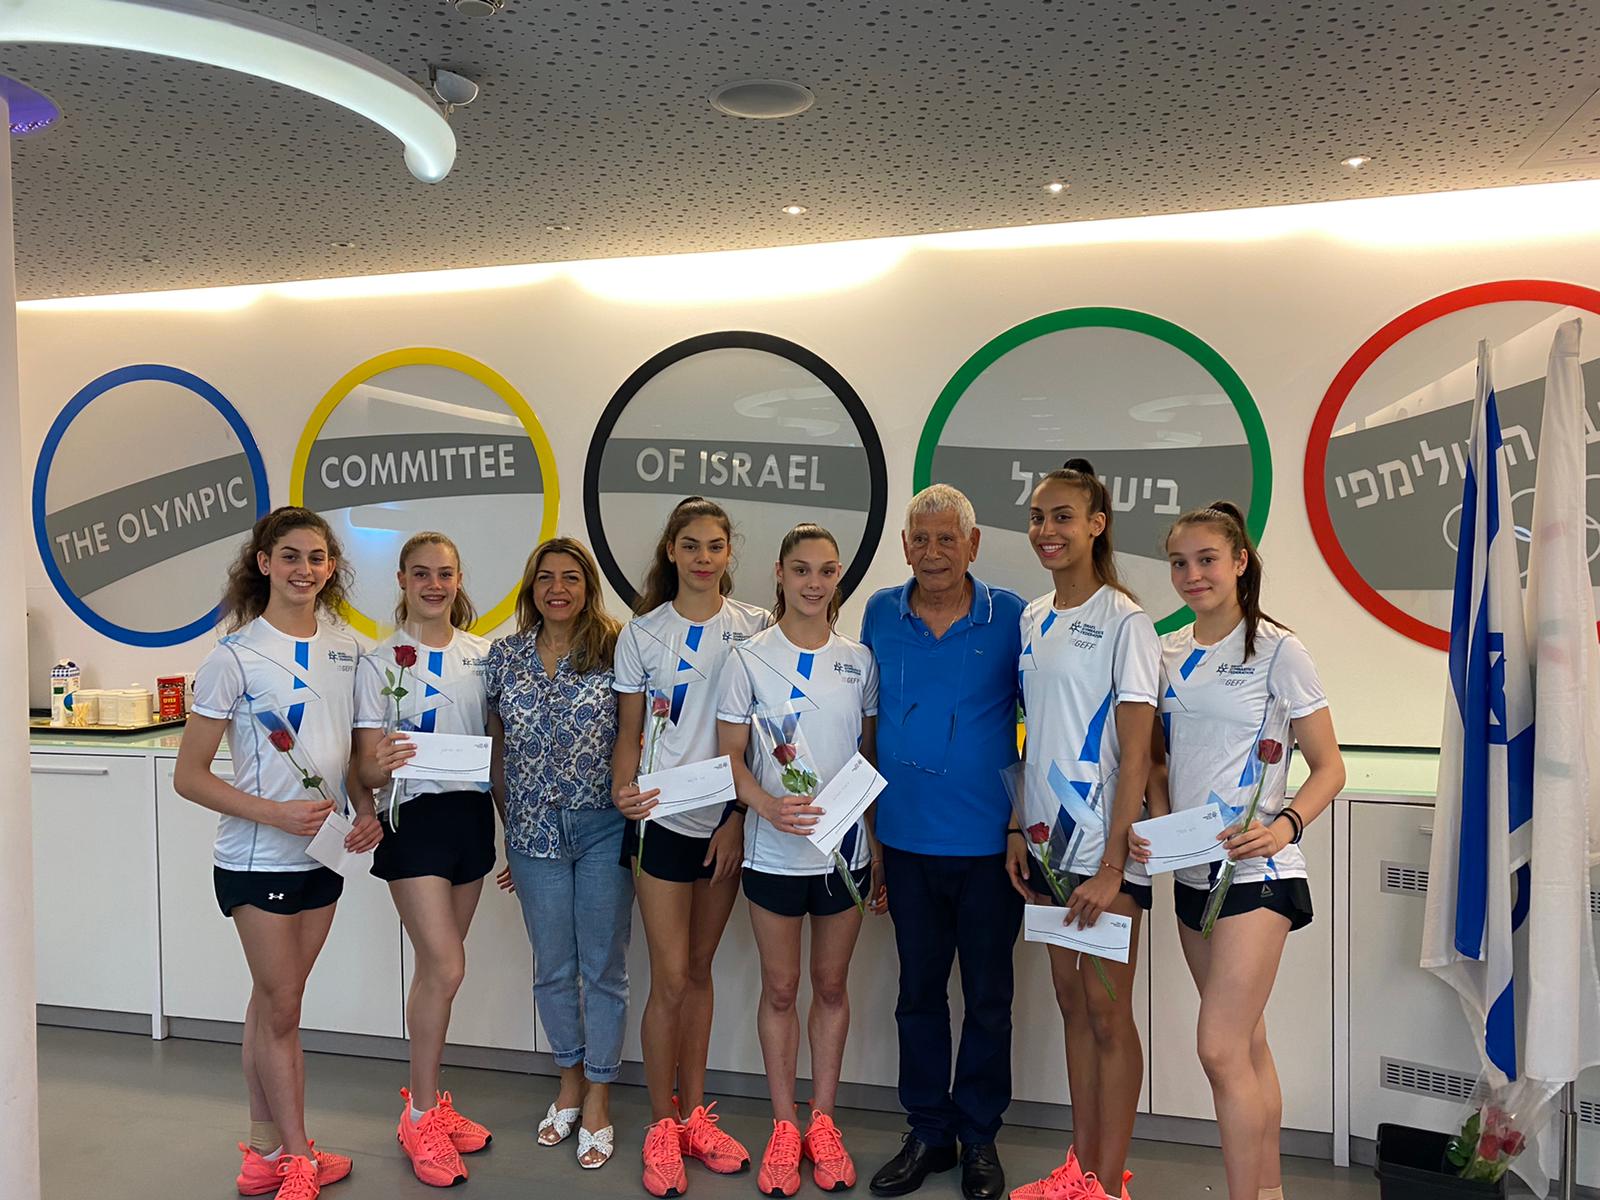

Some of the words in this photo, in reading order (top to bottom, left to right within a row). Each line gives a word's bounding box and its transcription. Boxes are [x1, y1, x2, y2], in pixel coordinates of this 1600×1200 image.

[320, 443, 515, 489] COMMITTEE
[636, 447, 686, 482] OF
[699, 450, 826, 491] ISRAEL
[1011, 461, 1181, 515] בישל
[1334, 424, 1536, 509] הולימפי
[55, 522, 110, 564] THE
[117, 476, 248, 544] OLYMPIC
[1074, 640, 1097, 650] GEFF
[1225, 679, 1247, 687] GEFF
